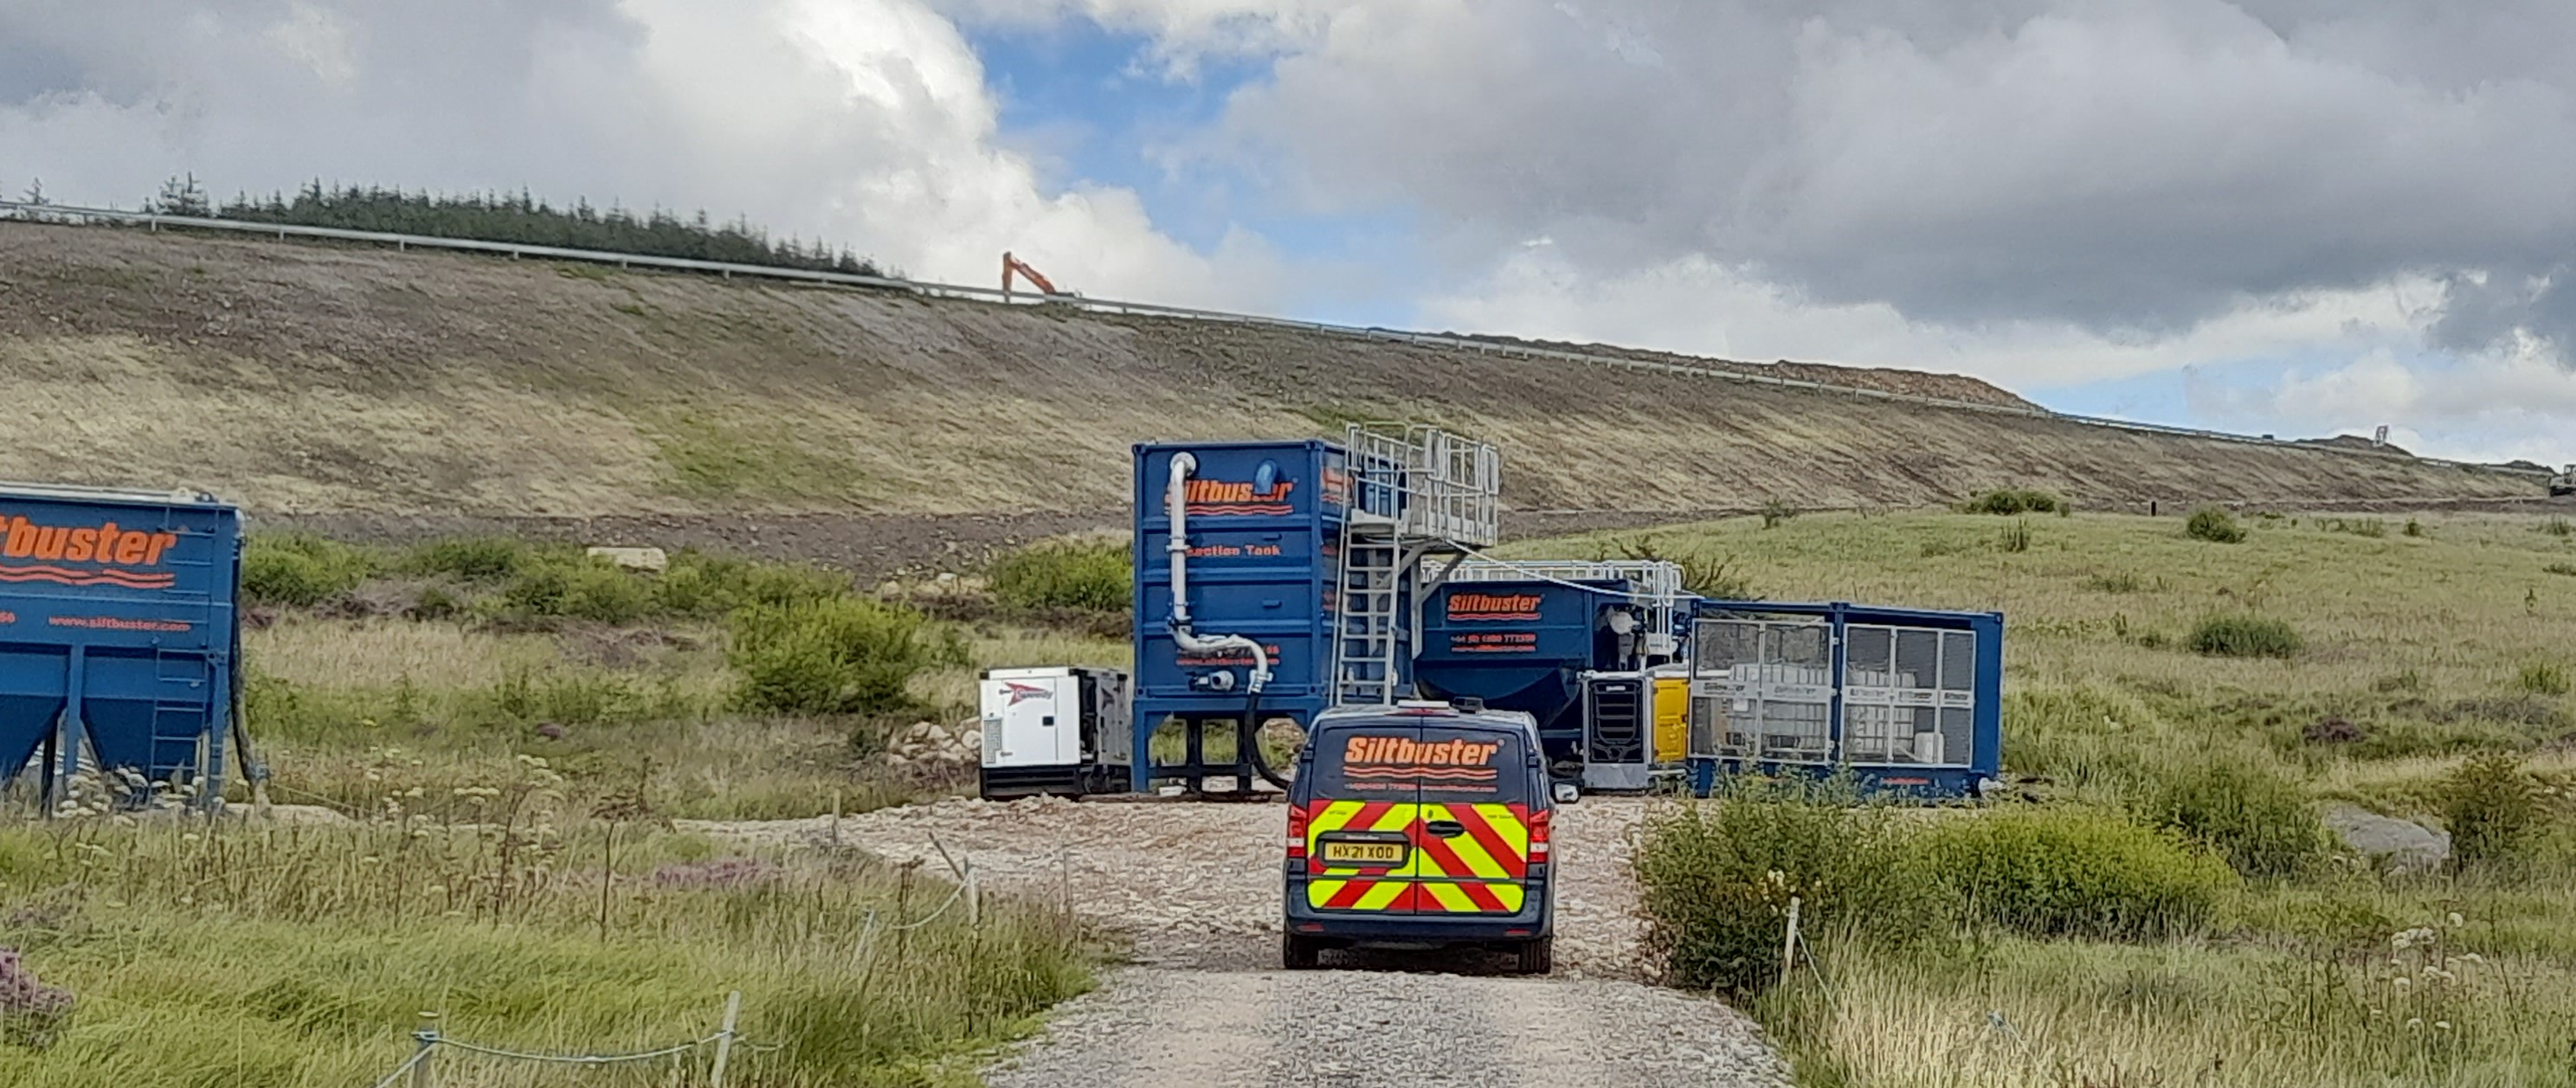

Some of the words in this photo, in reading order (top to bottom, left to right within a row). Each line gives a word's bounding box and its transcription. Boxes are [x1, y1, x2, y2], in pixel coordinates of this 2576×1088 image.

[1447, 594, 1542, 612] Siltbuster
[1343, 737, 1498, 766] Siltbuster
[1333, 845, 1364, 859] HX21
[1367, 846, 1394, 859] XOD
